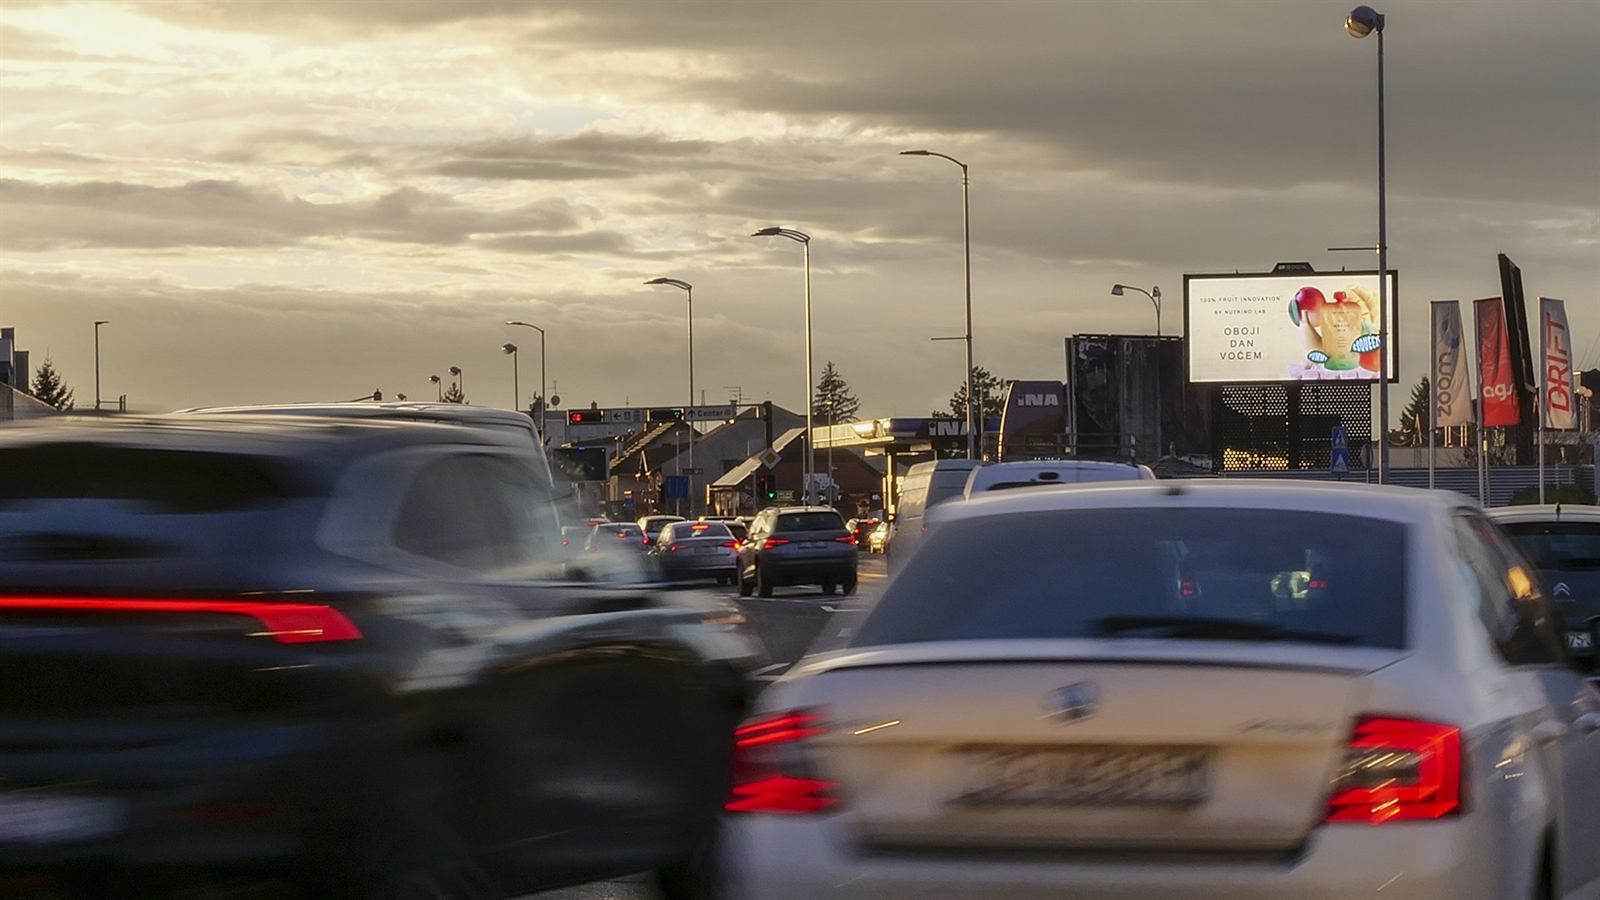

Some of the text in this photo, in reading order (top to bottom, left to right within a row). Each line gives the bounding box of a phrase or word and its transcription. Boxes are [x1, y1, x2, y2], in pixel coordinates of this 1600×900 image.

[1224, 327, 1260, 336] OBOJI
[1230, 339, 1254, 348] DAN
[1546, 311, 1570, 412] DRIFT
[1437, 351, 1452, 418] zoom
